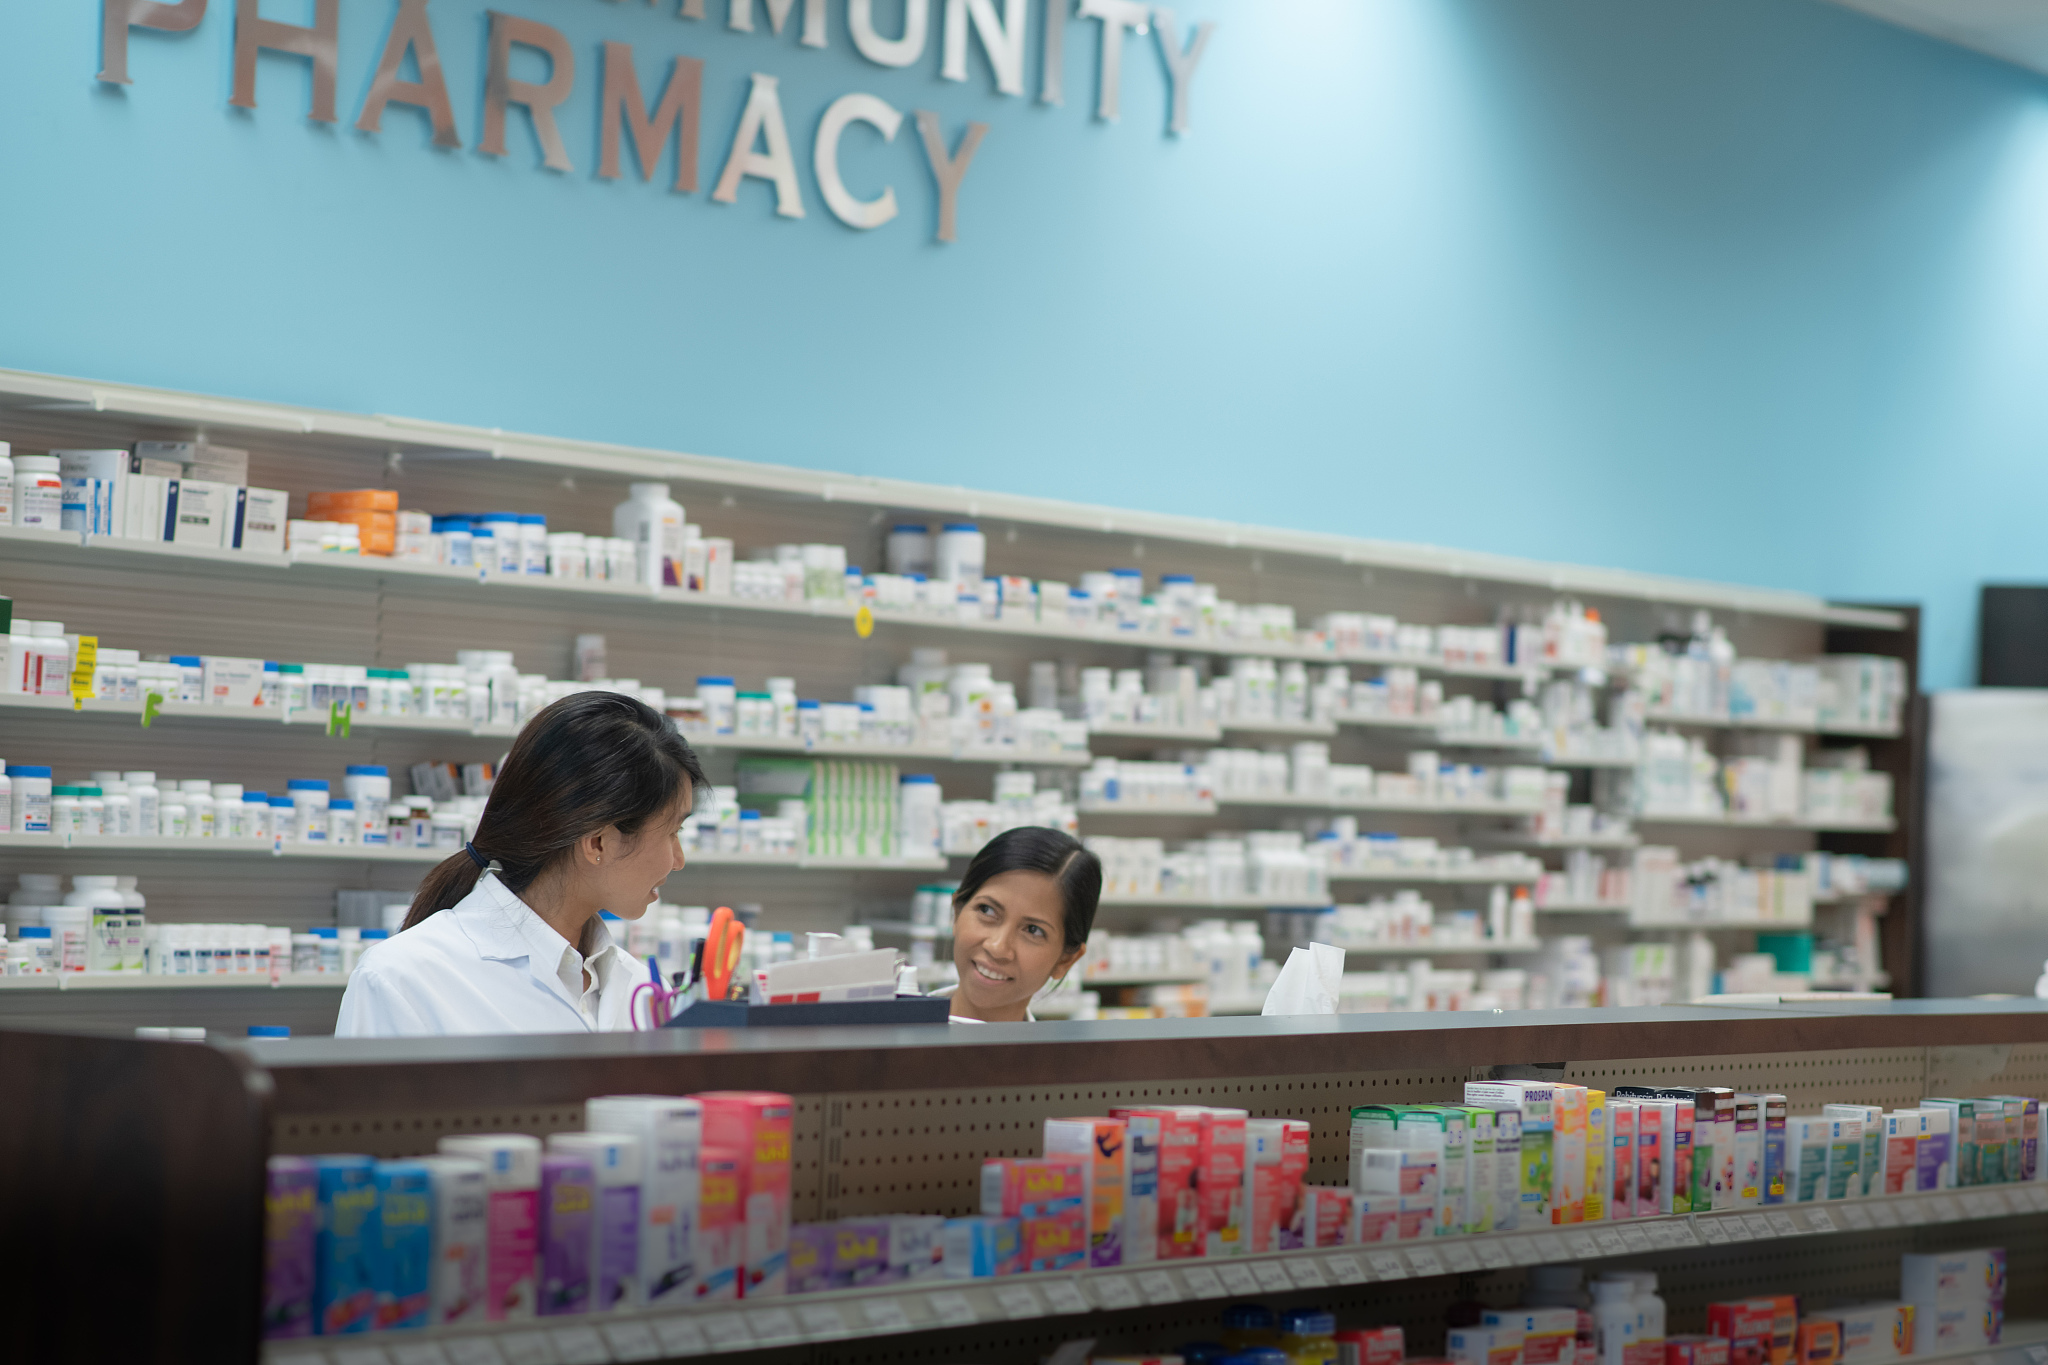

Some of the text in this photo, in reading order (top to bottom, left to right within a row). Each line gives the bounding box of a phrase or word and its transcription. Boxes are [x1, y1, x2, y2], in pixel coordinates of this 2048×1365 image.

[645, 0, 1214, 136] UNITY
[97, 0, 990, 242] PHARMACY
[328, 701, 352, 739] H
[1524, 1089, 1554, 1102] PROSPAN
